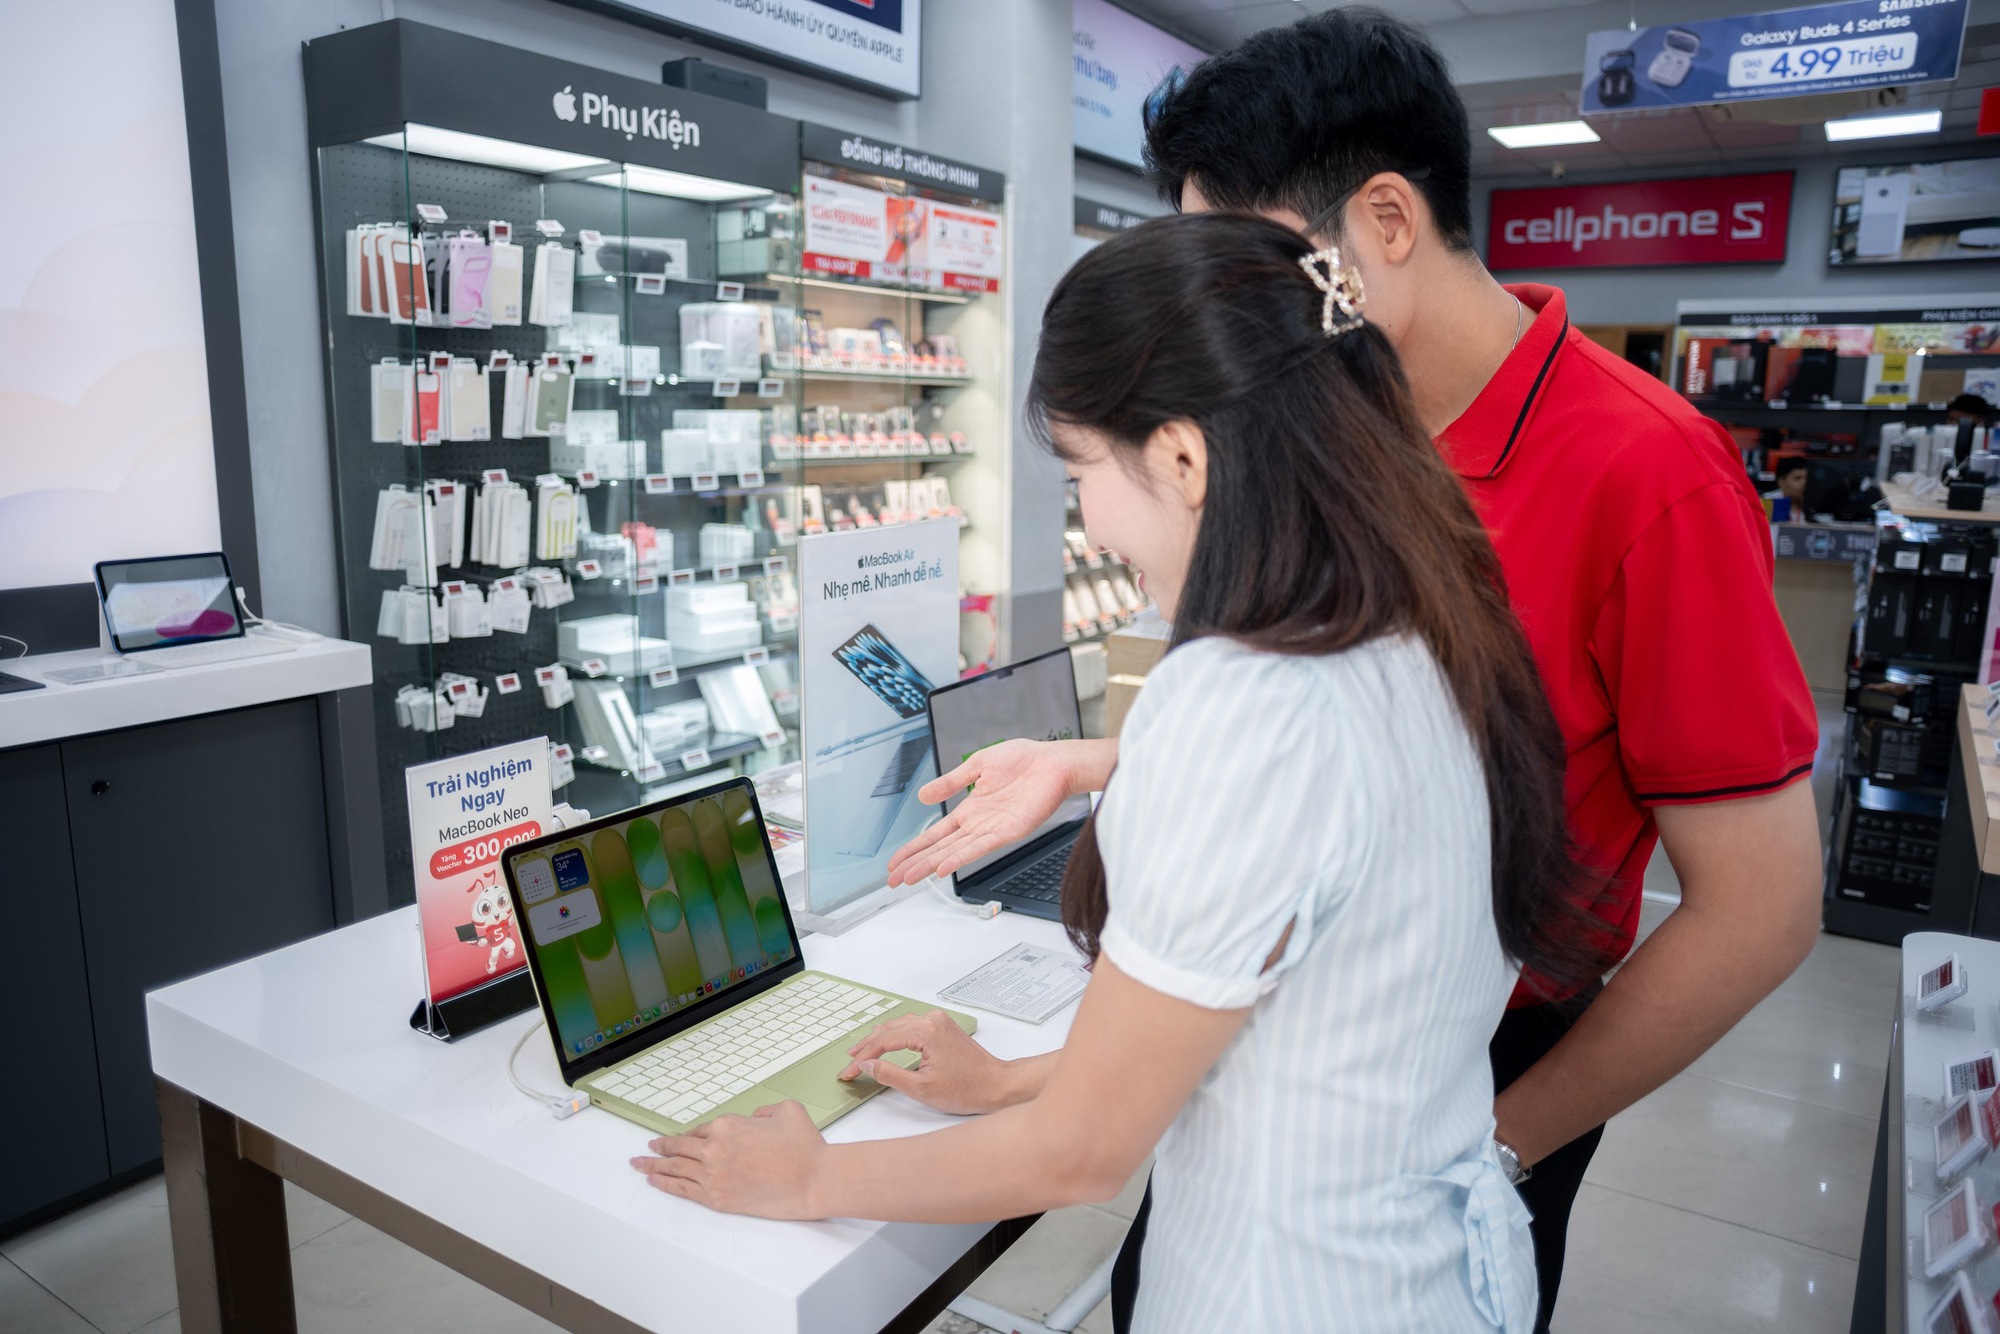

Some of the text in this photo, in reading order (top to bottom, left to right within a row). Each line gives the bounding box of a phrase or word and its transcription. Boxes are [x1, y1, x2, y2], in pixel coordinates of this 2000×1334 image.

[1740, 14, 1912, 47] Galaxy Buds 4 Series
[869, 38, 904, 63] APPLE
[1769, 45, 1904, 79] 4.99 Triệu
[582, 92, 700, 151] Phụ Kiện
[947, 165, 980, 189] MINH
[1503, 204, 1720, 253] cellphone
[864, 548, 916, 569] MacBook Air
[823, 582, 849, 601] Nhẹ
[851, 574, 873, 595] mê.
[874, 568, 911, 590] Nhanh
[913, 561, 927, 581] dễ
[426, 758, 532, 799] Trải Nghiệm
[461, 788, 506, 813] Ngay
[438, 806, 529, 844] MacBook Neo
[436, 860, 463, 873] Voucher
[441, 853, 457, 864] Tặng
[556, 860, 570, 872] 34°
